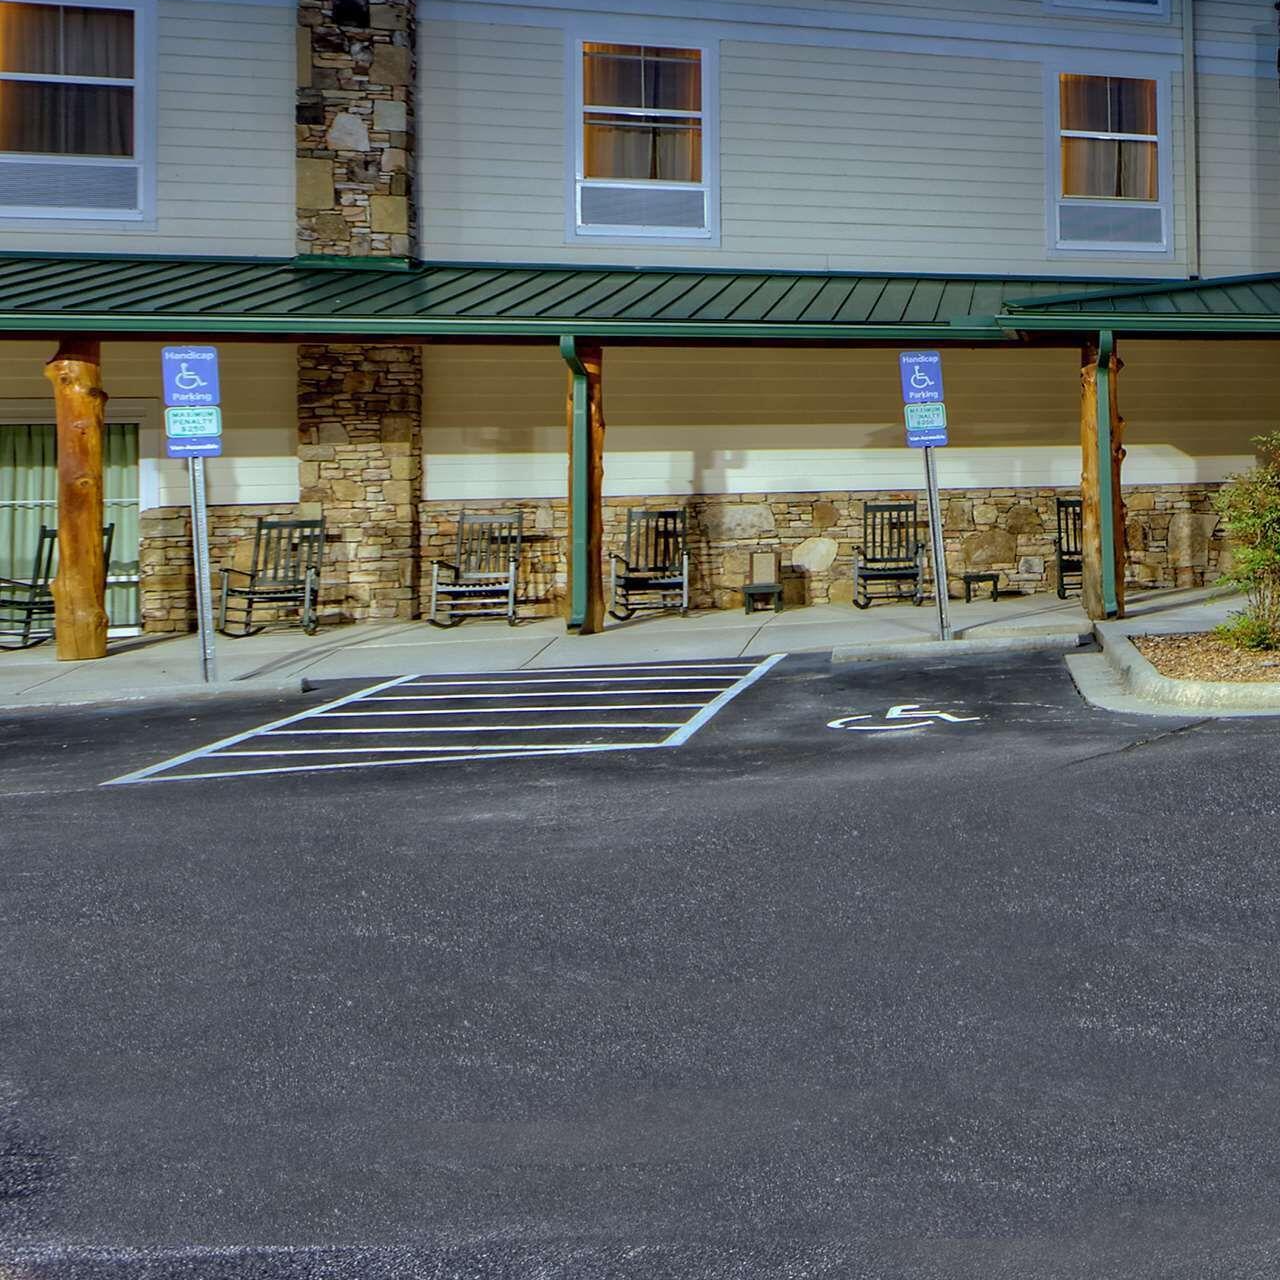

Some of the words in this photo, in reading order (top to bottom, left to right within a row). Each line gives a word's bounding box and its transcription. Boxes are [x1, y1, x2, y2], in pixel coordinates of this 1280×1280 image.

[165, 351, 215, 361] Handicap
[902, 355, 939, 363] Handicap
[172, 392, 213, 402] Parking
[908, 391, 939, 400] Parking
